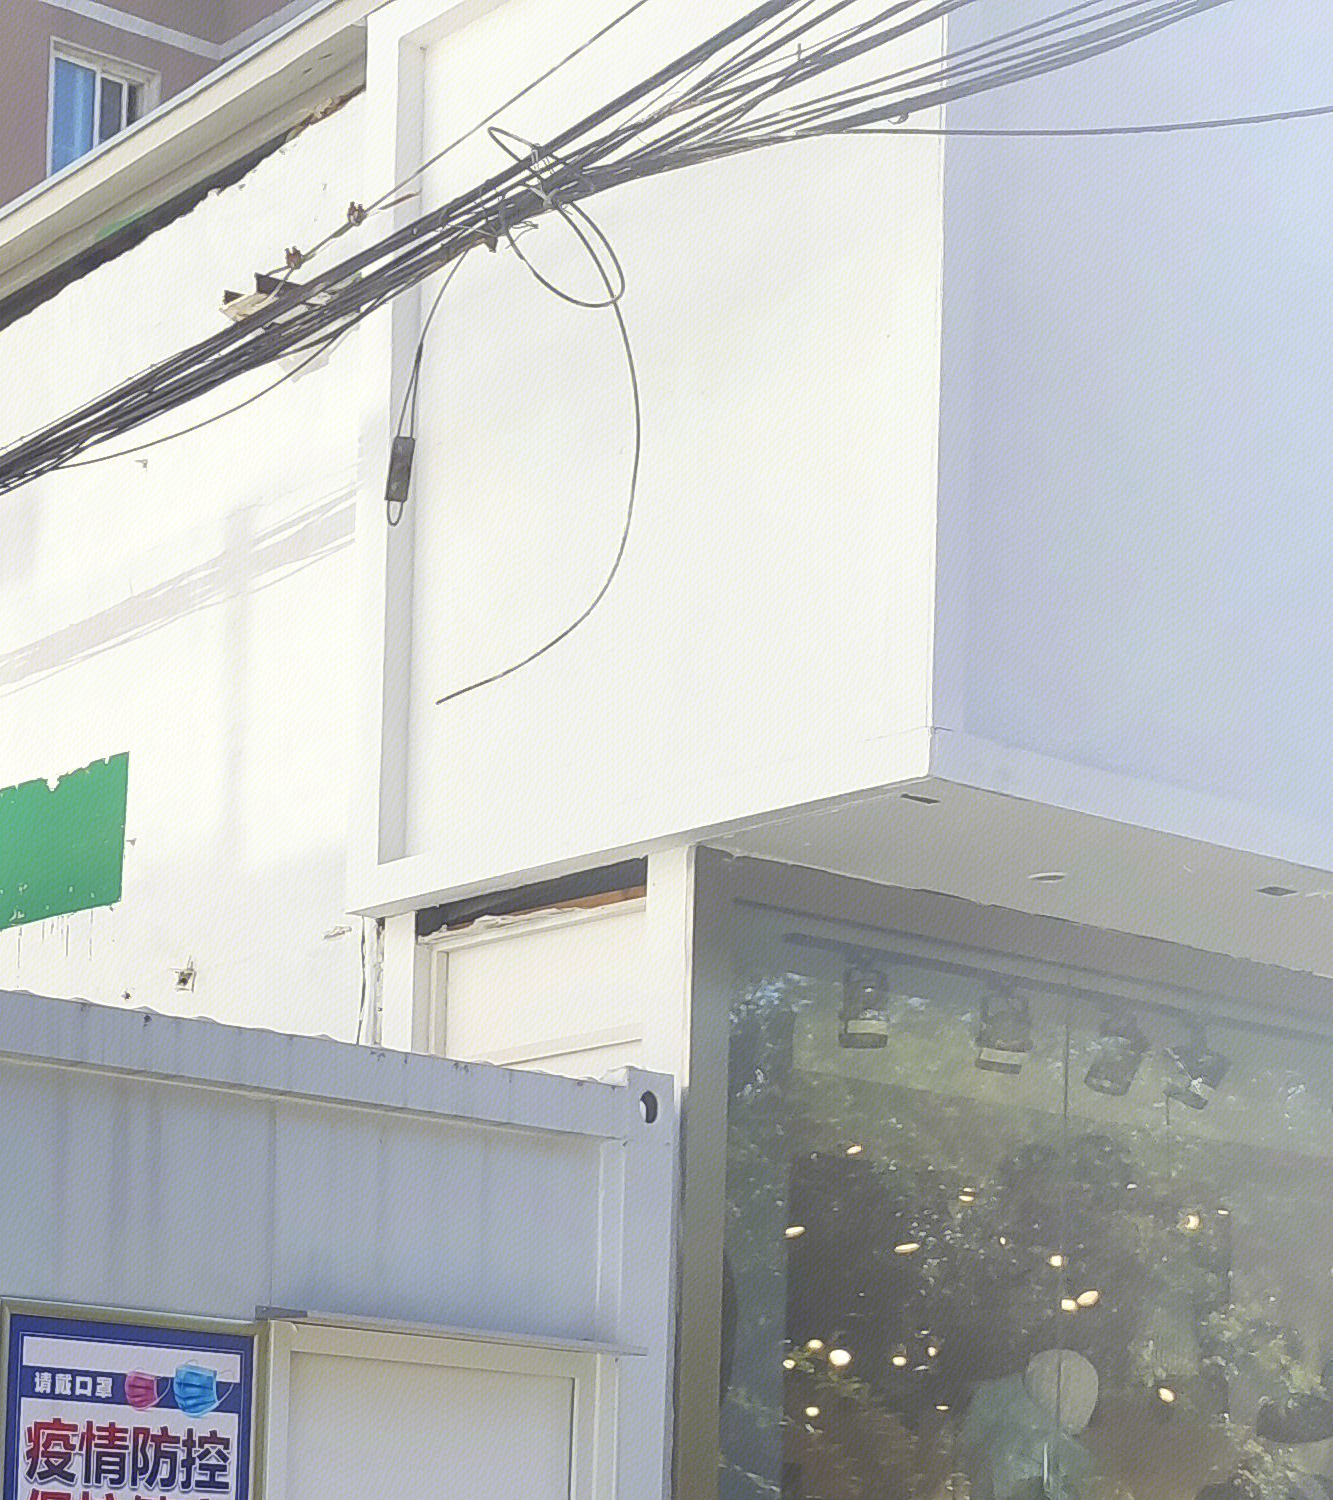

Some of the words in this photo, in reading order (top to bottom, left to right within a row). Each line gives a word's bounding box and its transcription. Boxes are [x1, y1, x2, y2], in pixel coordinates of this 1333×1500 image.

[34, 1371, 113, 1399] 请戴口罩
[25, 1418, 231, 1491] 疫情防控
